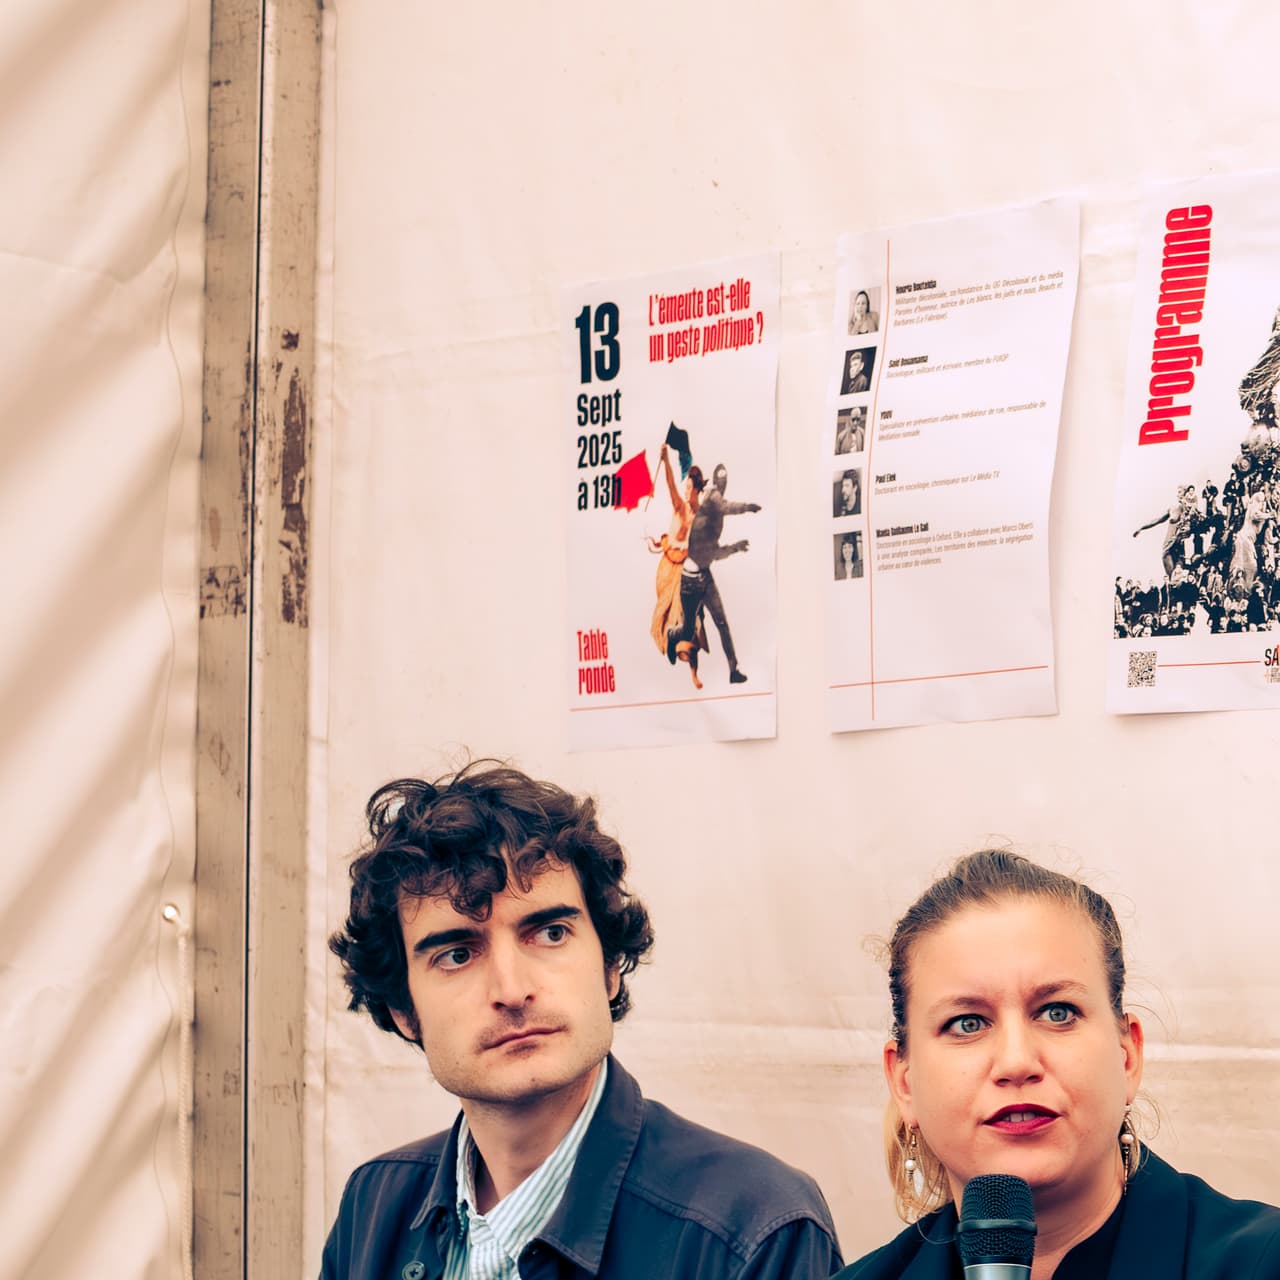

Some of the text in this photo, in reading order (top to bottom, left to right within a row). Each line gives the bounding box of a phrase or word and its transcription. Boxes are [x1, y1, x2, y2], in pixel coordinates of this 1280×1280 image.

[649, 278, 751, 326] L'émeute est-elle
[575, 301, 620, 384] 13
[650, 311, 764, 363] un geste politique ?
[1138, 204, 1213, 445] Programme
[577, 389, 622, 427] Sept
[577, 431, 622, 469] 2025
[578, 474, 622, 511] à 13h
[577, 629, 608, 661] Table
[578, 662, 616, 695] ronde
